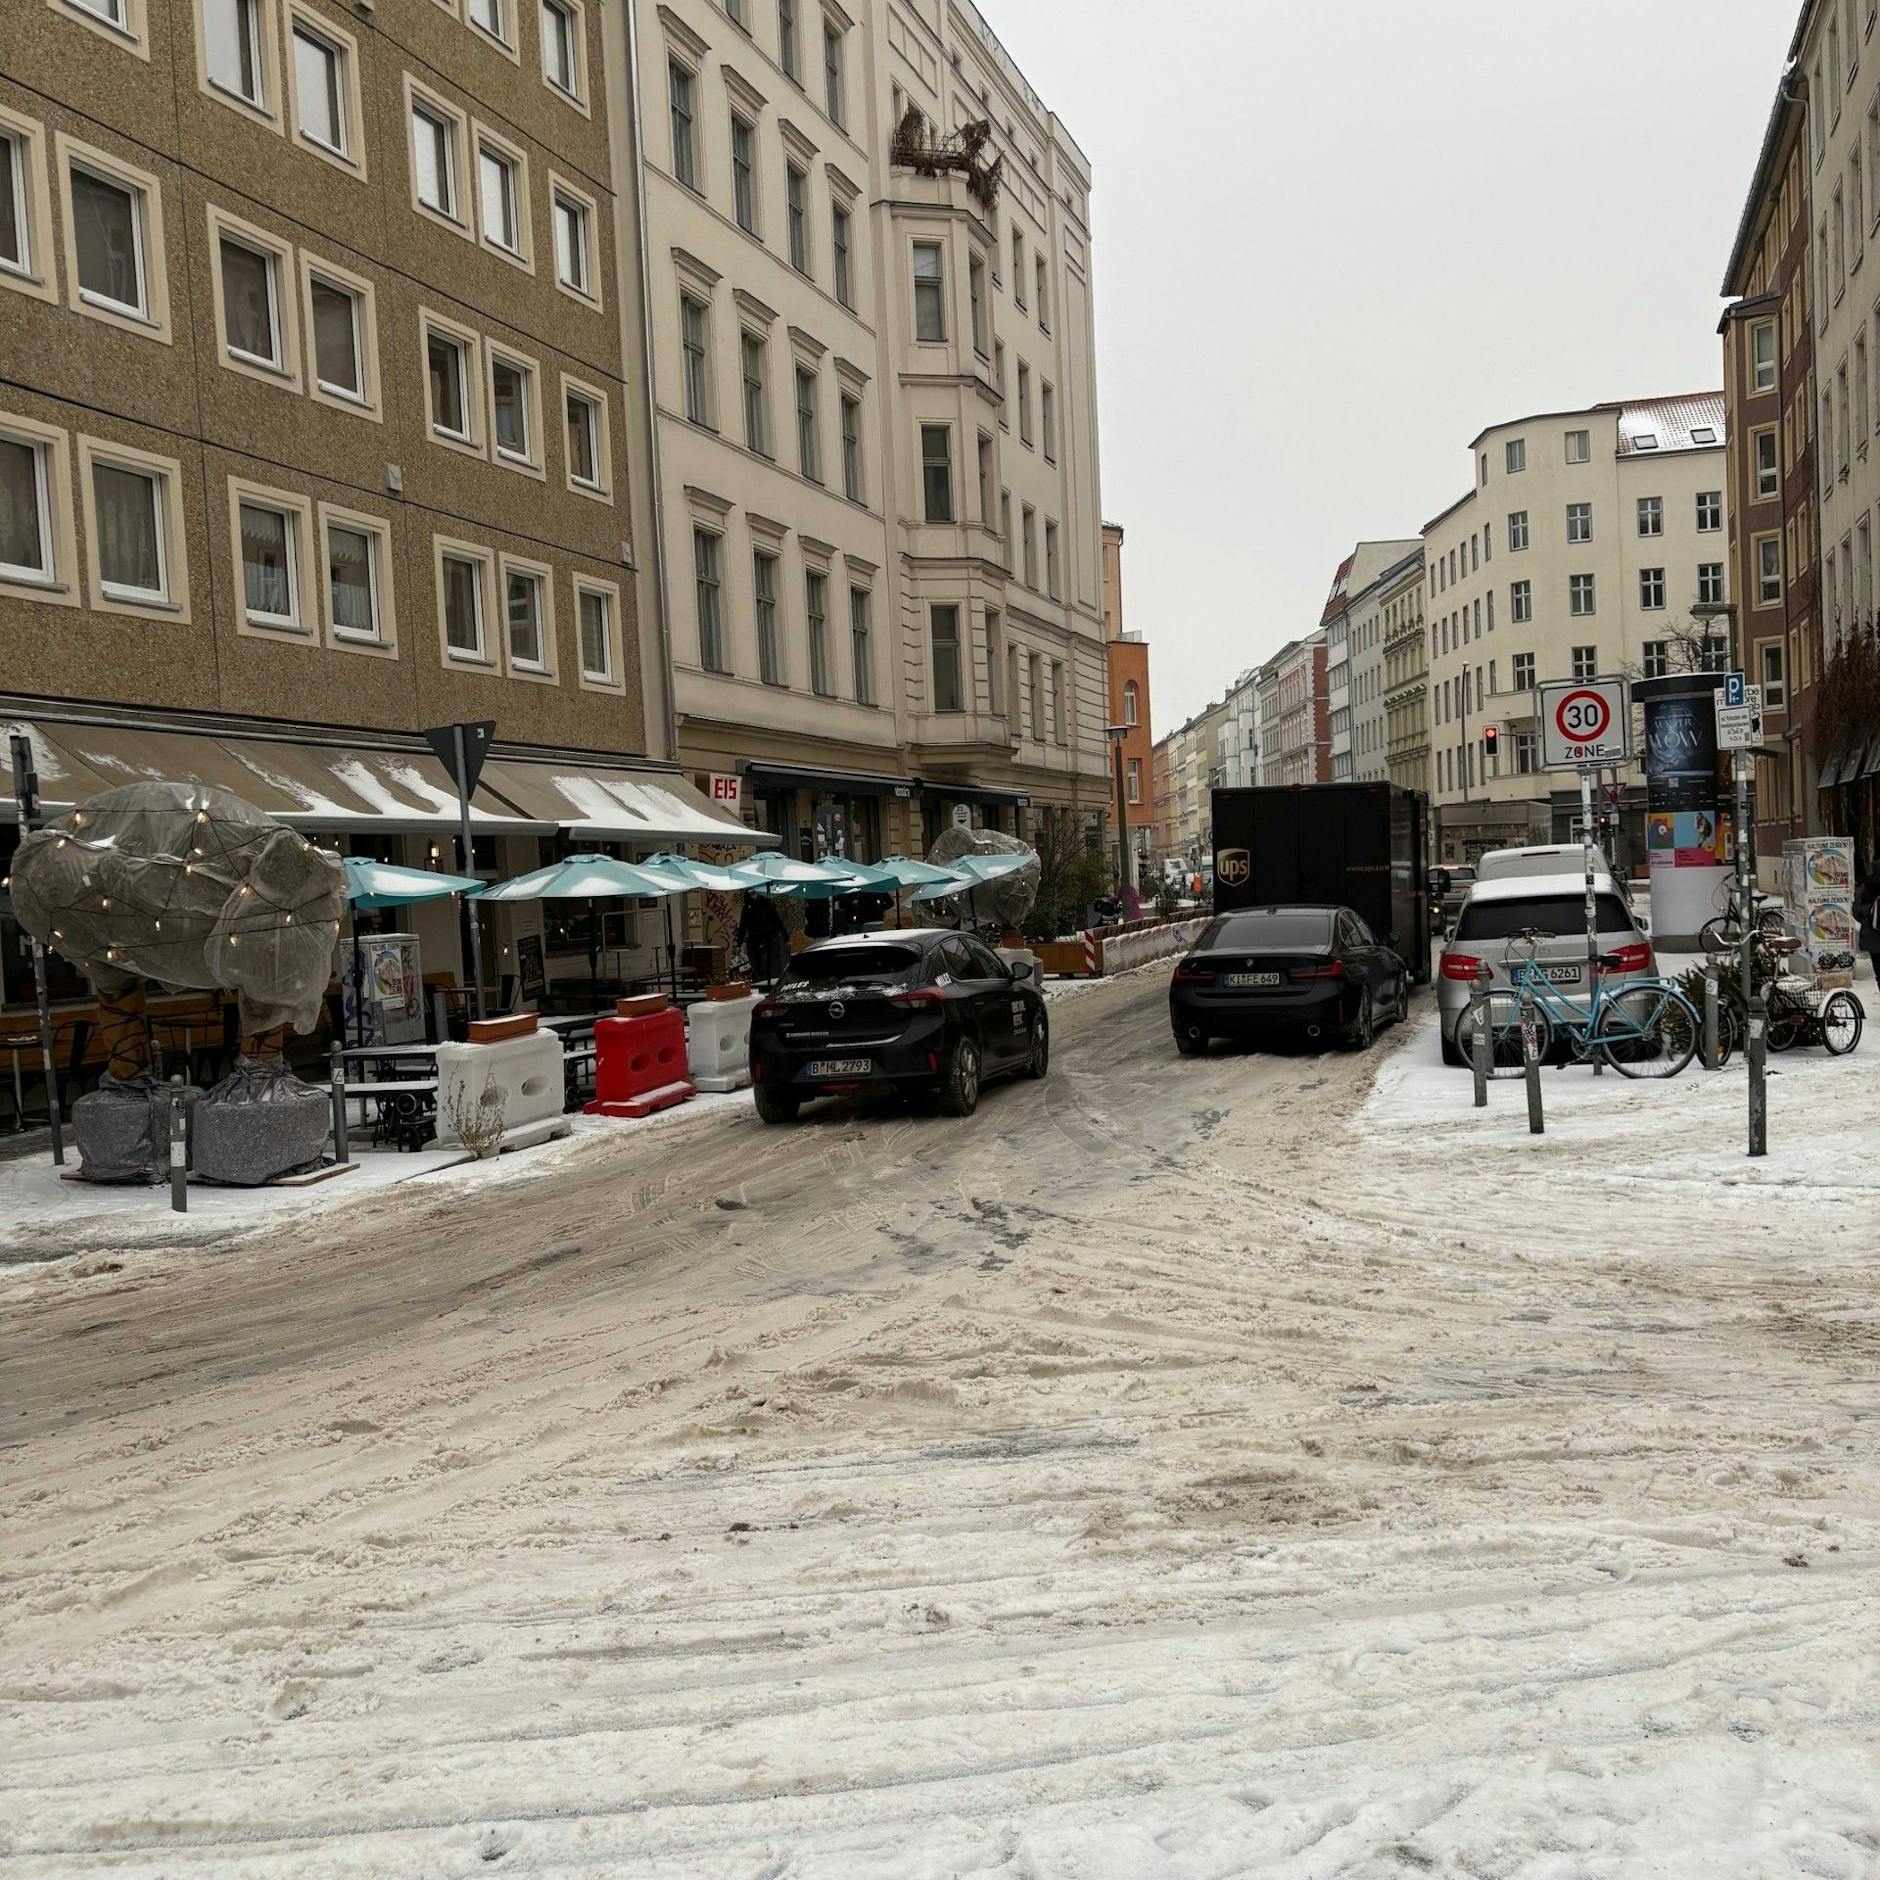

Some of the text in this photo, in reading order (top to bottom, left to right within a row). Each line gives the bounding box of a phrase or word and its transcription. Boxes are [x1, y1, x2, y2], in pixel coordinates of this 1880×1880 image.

[1728, 677, 1740, 703] P
[1568, 704, 1598, 728] 30
[1564, 744, 1605, 759] ZONE
[714, 779, 737, 799] EIS
[1220, 860, 1248, 881] ups
[1261, 974, 1278, 984] 649
[1550, 968, 1578, 979] 6261
[812, 1063, 819, 1074] B
[842, 1059, 870, 1072] 2793
